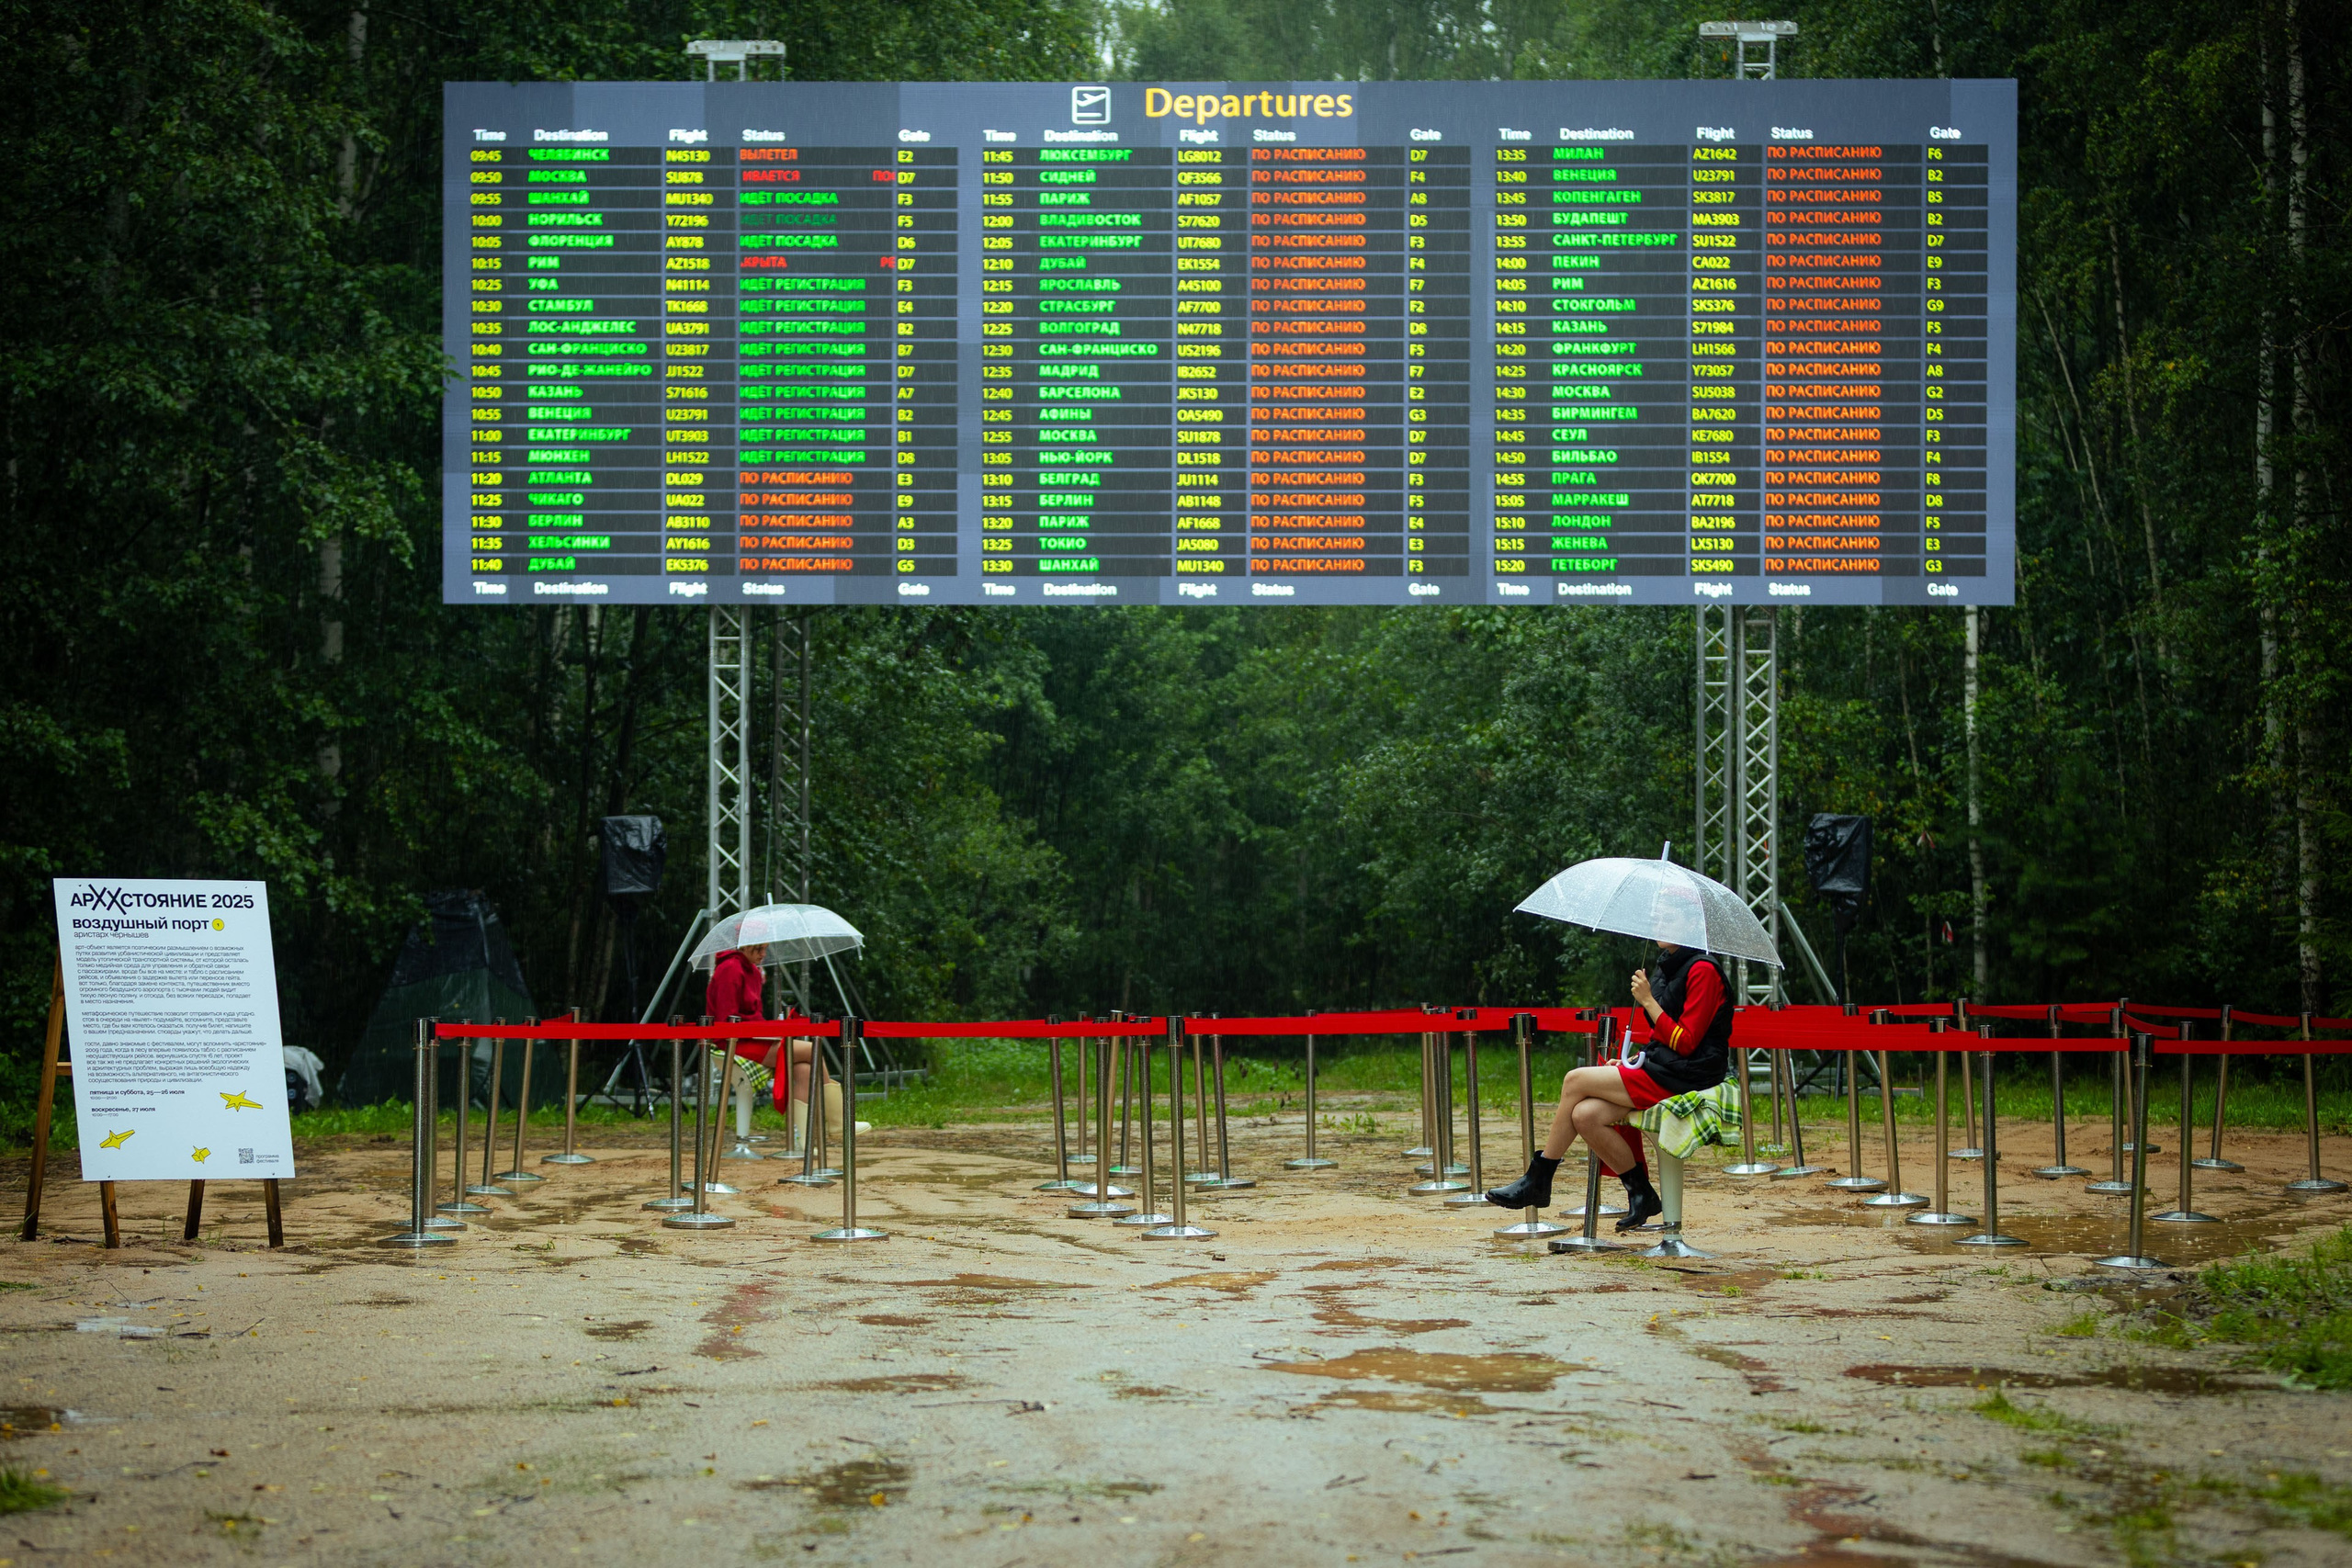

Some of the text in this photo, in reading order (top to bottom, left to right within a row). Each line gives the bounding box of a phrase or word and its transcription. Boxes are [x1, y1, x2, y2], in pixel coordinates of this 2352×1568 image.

[1146, 88, 1353, 125] Departures
[474, 129, 931, 144] Time Destination Flight Status Gate
[983, 129, 1442, 144] Time Destination Flight Status Gate
[1498, 127, 1962, 141] Time Destination Flight Status Gate
[471, 149, 913, 163] 09:45 ЧЕЛЯБИНСК N45130 ВЫЛЕТЕЛ E2
[984, 149, 1427, 163] 11:45 ЛЮКСЕМБУРГ LG8012 ПО РАСПИСАНИЮ D7
[1498, 147, 1942, 161] 13:35 МИЛАН AZ1642 ПО РАСПИСАНИЮ F6
[471, 193, 502, 205] 09:55
[528, 190, 590, 204] ШАНХАЙ
[666, 193, 713, 205] MU1340
[775, 193, 839, 206] ПОСАДКА
[898, 194, 912, 205] F3
[984, 213, 1427, 228] 12:00 ВЛАДИВОСТОК S77620 ПО РАСПИСАНИЮ D5
[1497, 233, 1944, 248] 13:55 САНКТ-ПЕТЕРБУРГ SU1522 ПО РАСПИСАНИЮ D7
[472, 300, 502, 312] 10:30
[527, 299, 594, 312] СТАМБУЛ
[666, 300, 707, 312] TK1668
[775, 300, 865, 313] РЕГИСТРАЦИЯ
[898, 301, 913, 313] E4
[983, 300, 1424, 313] 12:20 СТРАСБУРГ AF7700 ПО РАСПИСАНИЮ F2
[1497, 342, 1941, 355] 14:20 ФРАНКФУРТ LH1566 ПО РАСПИСАНИЮ F4
[472, 387, 502, 399] 10:50
[527, 385, 583, 398] КАЗАНЬ
[666, 387, 707, 399] S71616
[775, 386, 865, 400] РЕГИСТРАЦИЯ
[898, 388, 914, 399] A7
[1497, 407, 1943, 421] 14:35 БИРМИНГЕМ BA7620 ПО РАСПИСАНИЮ D5
[983, 449, 1426, 465] 13:05 НЬЮ-ЙОРК DL1518 ПО РАСПИСАНИЮ D7
[472, 493, 913, 507] 11:25 ЧИКАГО UA022 ПО РАСПИСАНИЮ E9
[1496, 493, 1943, 507] 15:05 МАРРАКЕШ AT7718 ПО РАСПИСАНИЮ D8
[1497, 582, 1959, 597] Time Destination Flight Status Gate
[211, 894, 254, 908] 2025
[73, 917, 168, 931] воздушный
[173, 919, 209, 932] порт
